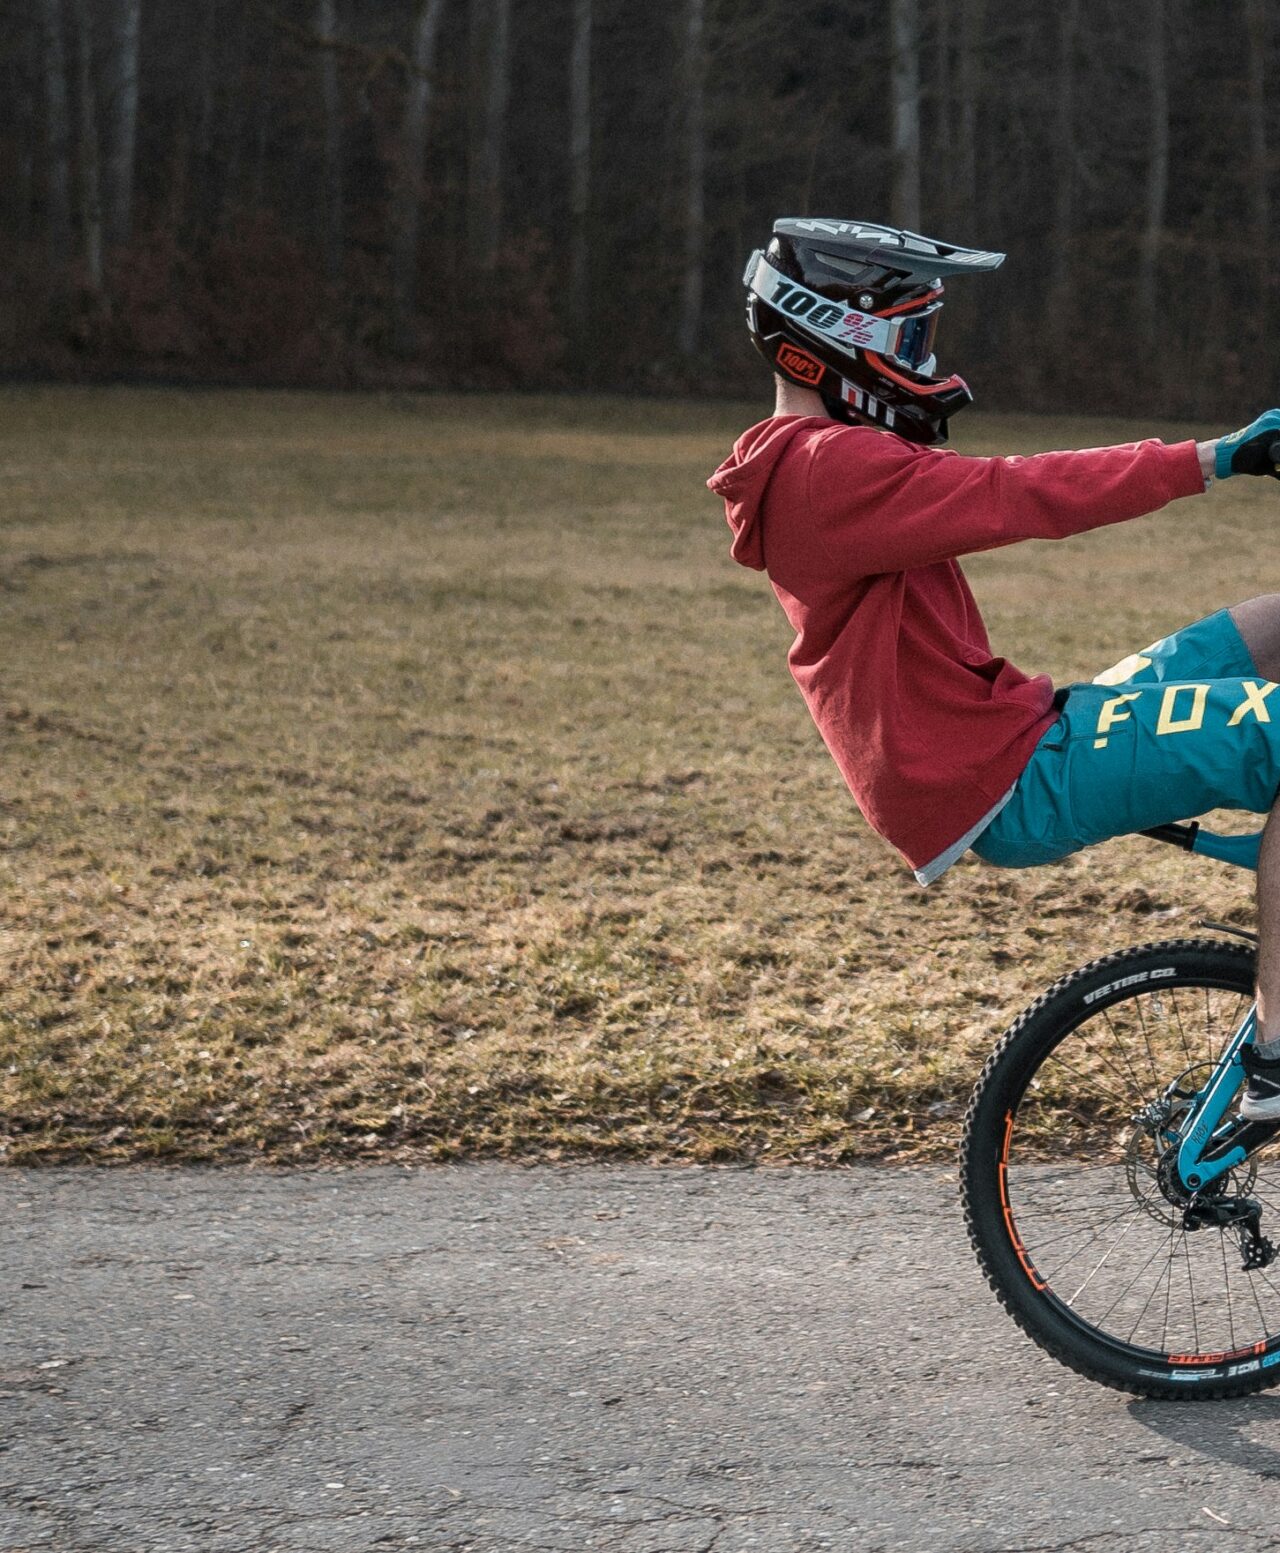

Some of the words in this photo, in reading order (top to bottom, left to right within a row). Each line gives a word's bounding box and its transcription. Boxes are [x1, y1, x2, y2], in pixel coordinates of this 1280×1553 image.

[770, 280, 880, 344] 100%
[782, 351, 819, 378] 100%
[1093, 682, 1279, 749] FOX
[1083, 984, 1112, 1005] VEE
[1111, 970, 1149, 991] TIRE
